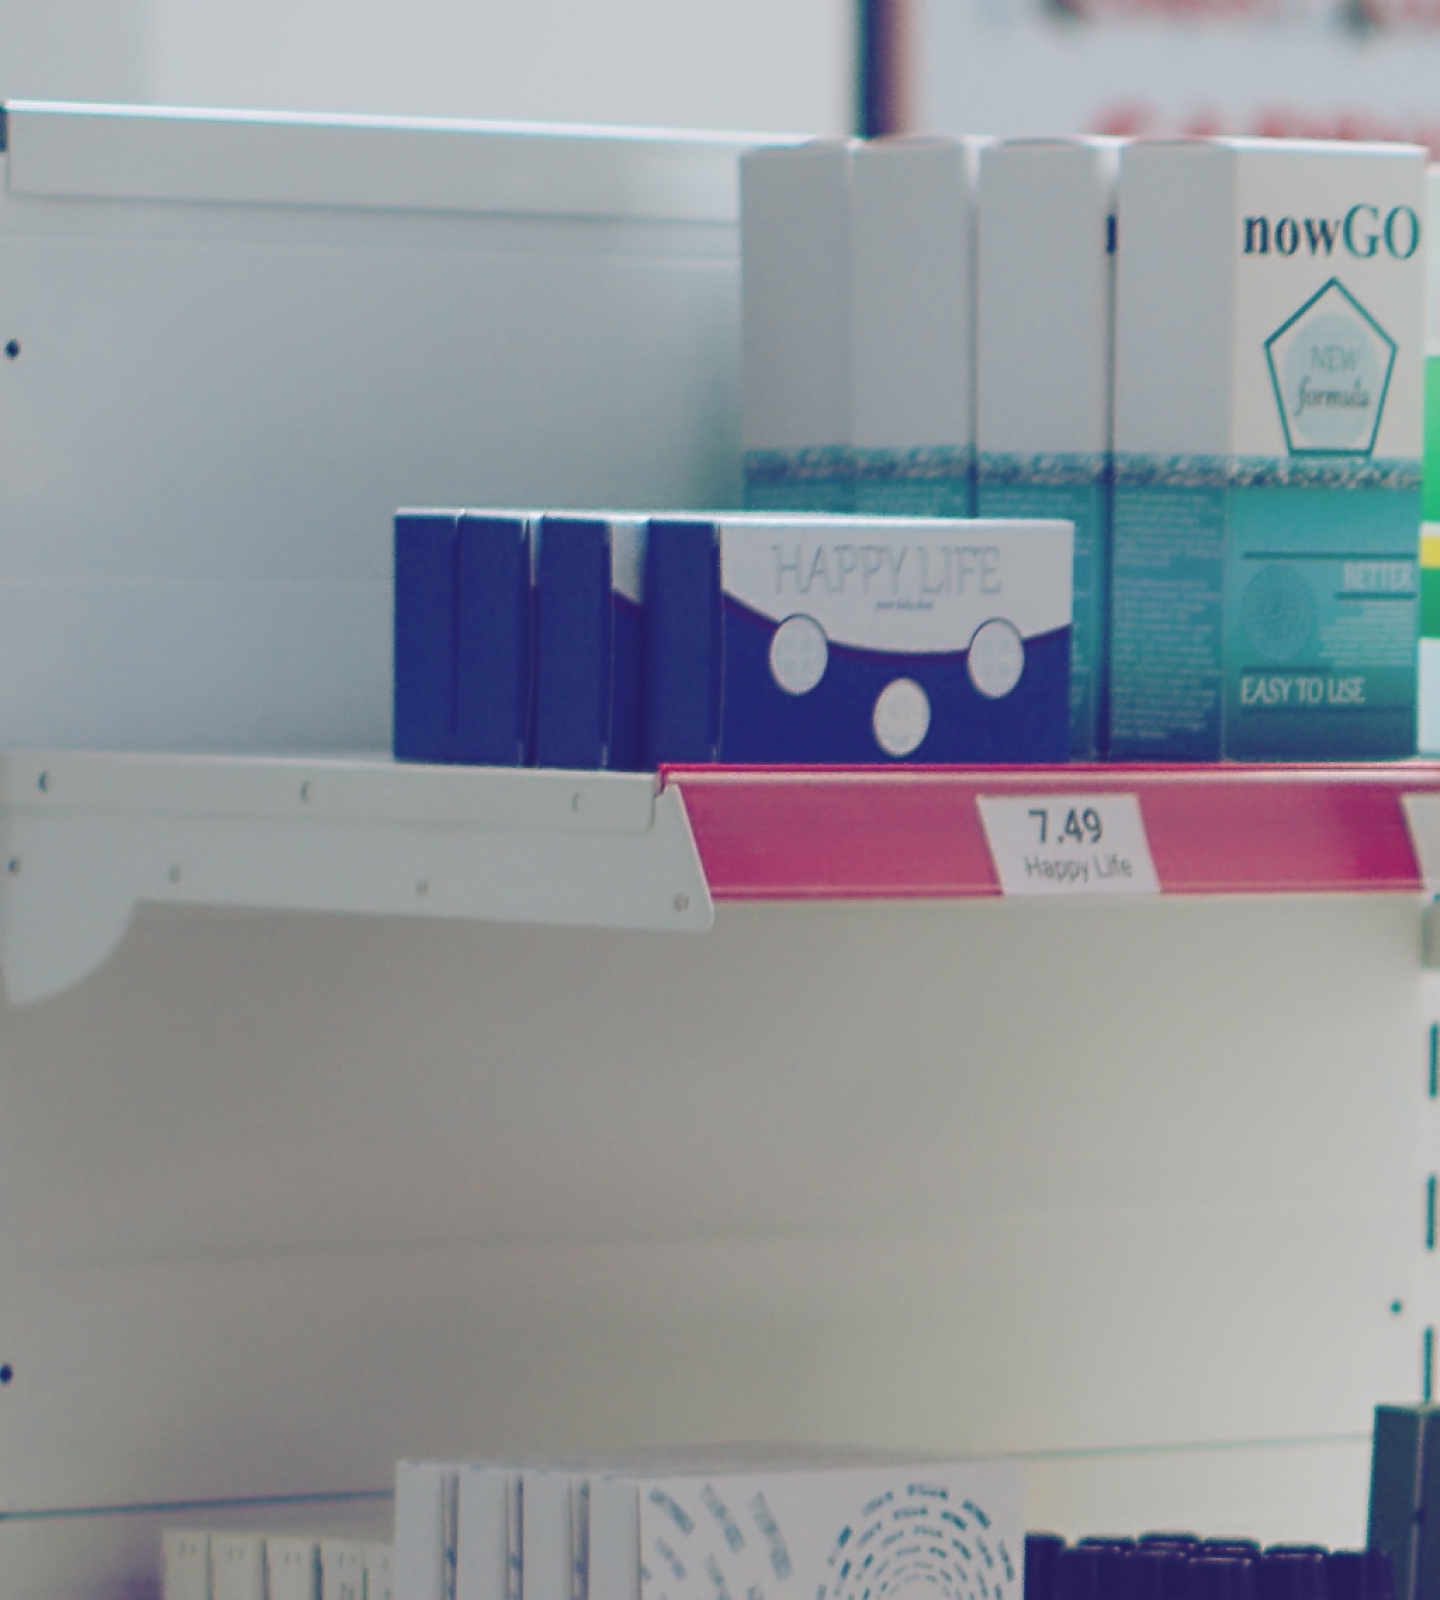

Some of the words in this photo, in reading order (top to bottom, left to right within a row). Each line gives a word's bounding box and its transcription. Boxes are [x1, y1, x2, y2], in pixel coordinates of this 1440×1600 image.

[1243, 203, 1421, 260] nowGO
[1311, 344, 1361, 373] NEW
[1294, 375, 1371, 418] formula
[771, 543, 909, 596] HAPPY
[917, 545, 1003, 597] LIFE
[1240, 677, 1293, 704] EASY
[1296, 677, 1324, 703] TO
[1327, 677, 1366, 703] USE
[1027, 806, 1104, 845] 7.49
[1023, 854, 1088, 884] Happy
[1092, 853, 1133, 879] Life
